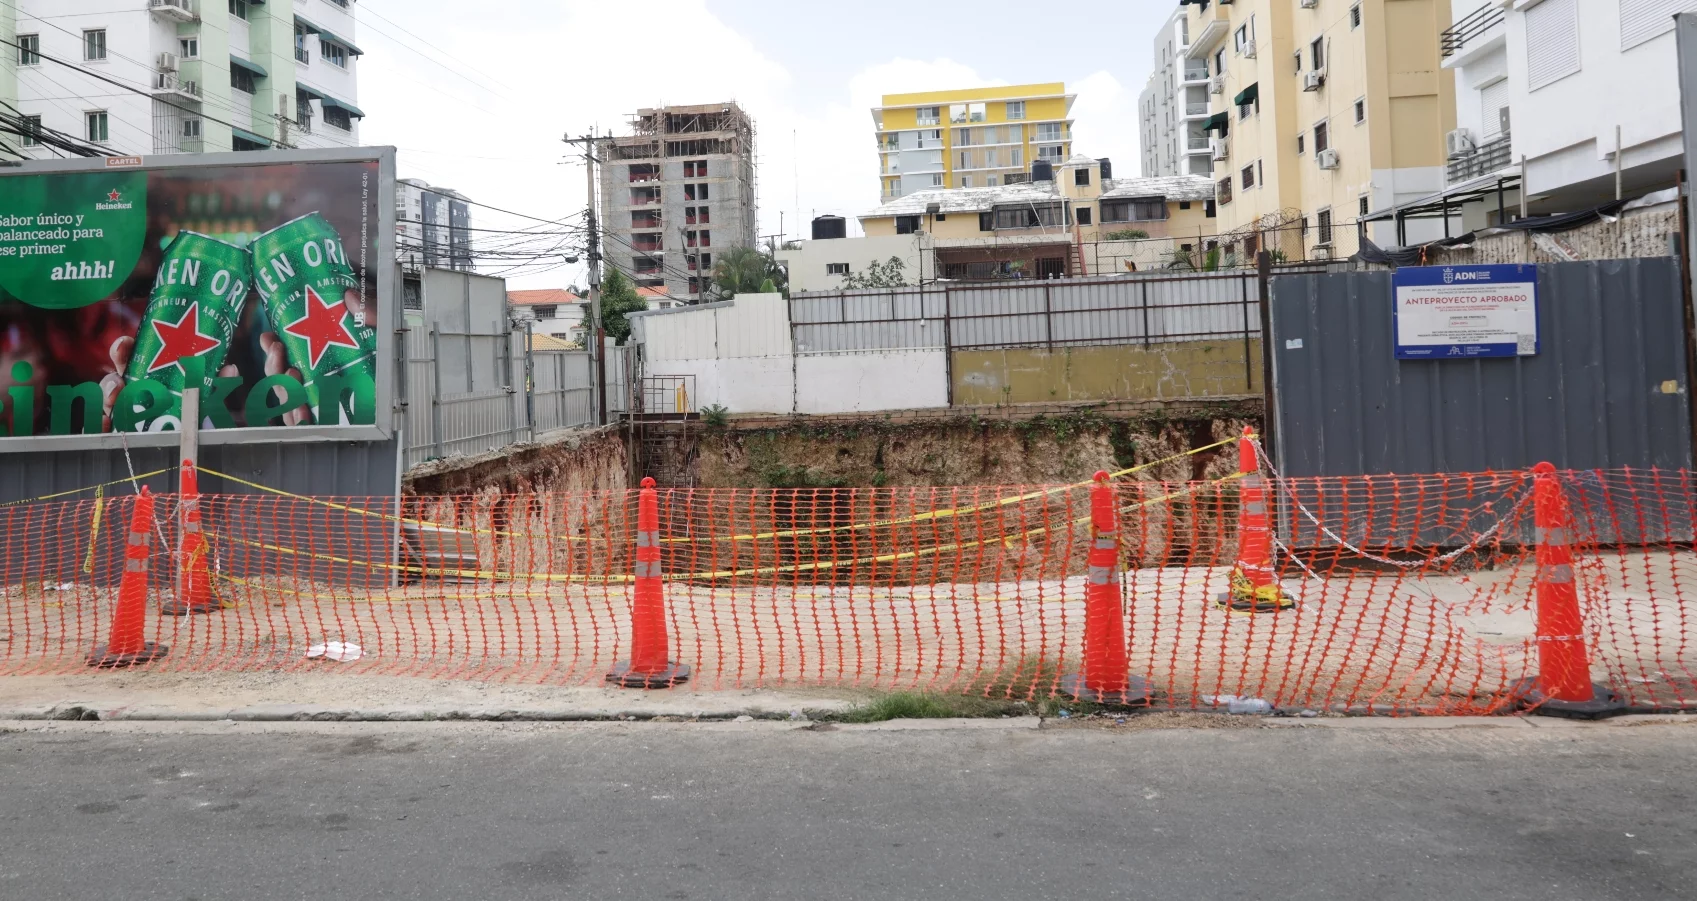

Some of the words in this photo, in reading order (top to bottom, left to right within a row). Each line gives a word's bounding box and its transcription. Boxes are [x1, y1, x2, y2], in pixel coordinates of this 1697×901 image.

[361, 188, 369, 199] Ley
[95, 202, 133, 210] Heineken
[36, 213, 73, 226] único
[75, 214, 85, 226] y
[72, 228, 104, 241] para
[20, 244, 66, 257] primer
[50, 260, 115, 280] ahhh!
[360, 268, 366, 277] de
[1455, 271, 1476, 280] ADN
[1405, 296, 1478, 305] ANTEPROYECTO
[1480, 294, 1528, 303] APROBADO
[354, 311, 364, 328] UB
[359, 328, 374, 340] 1873
